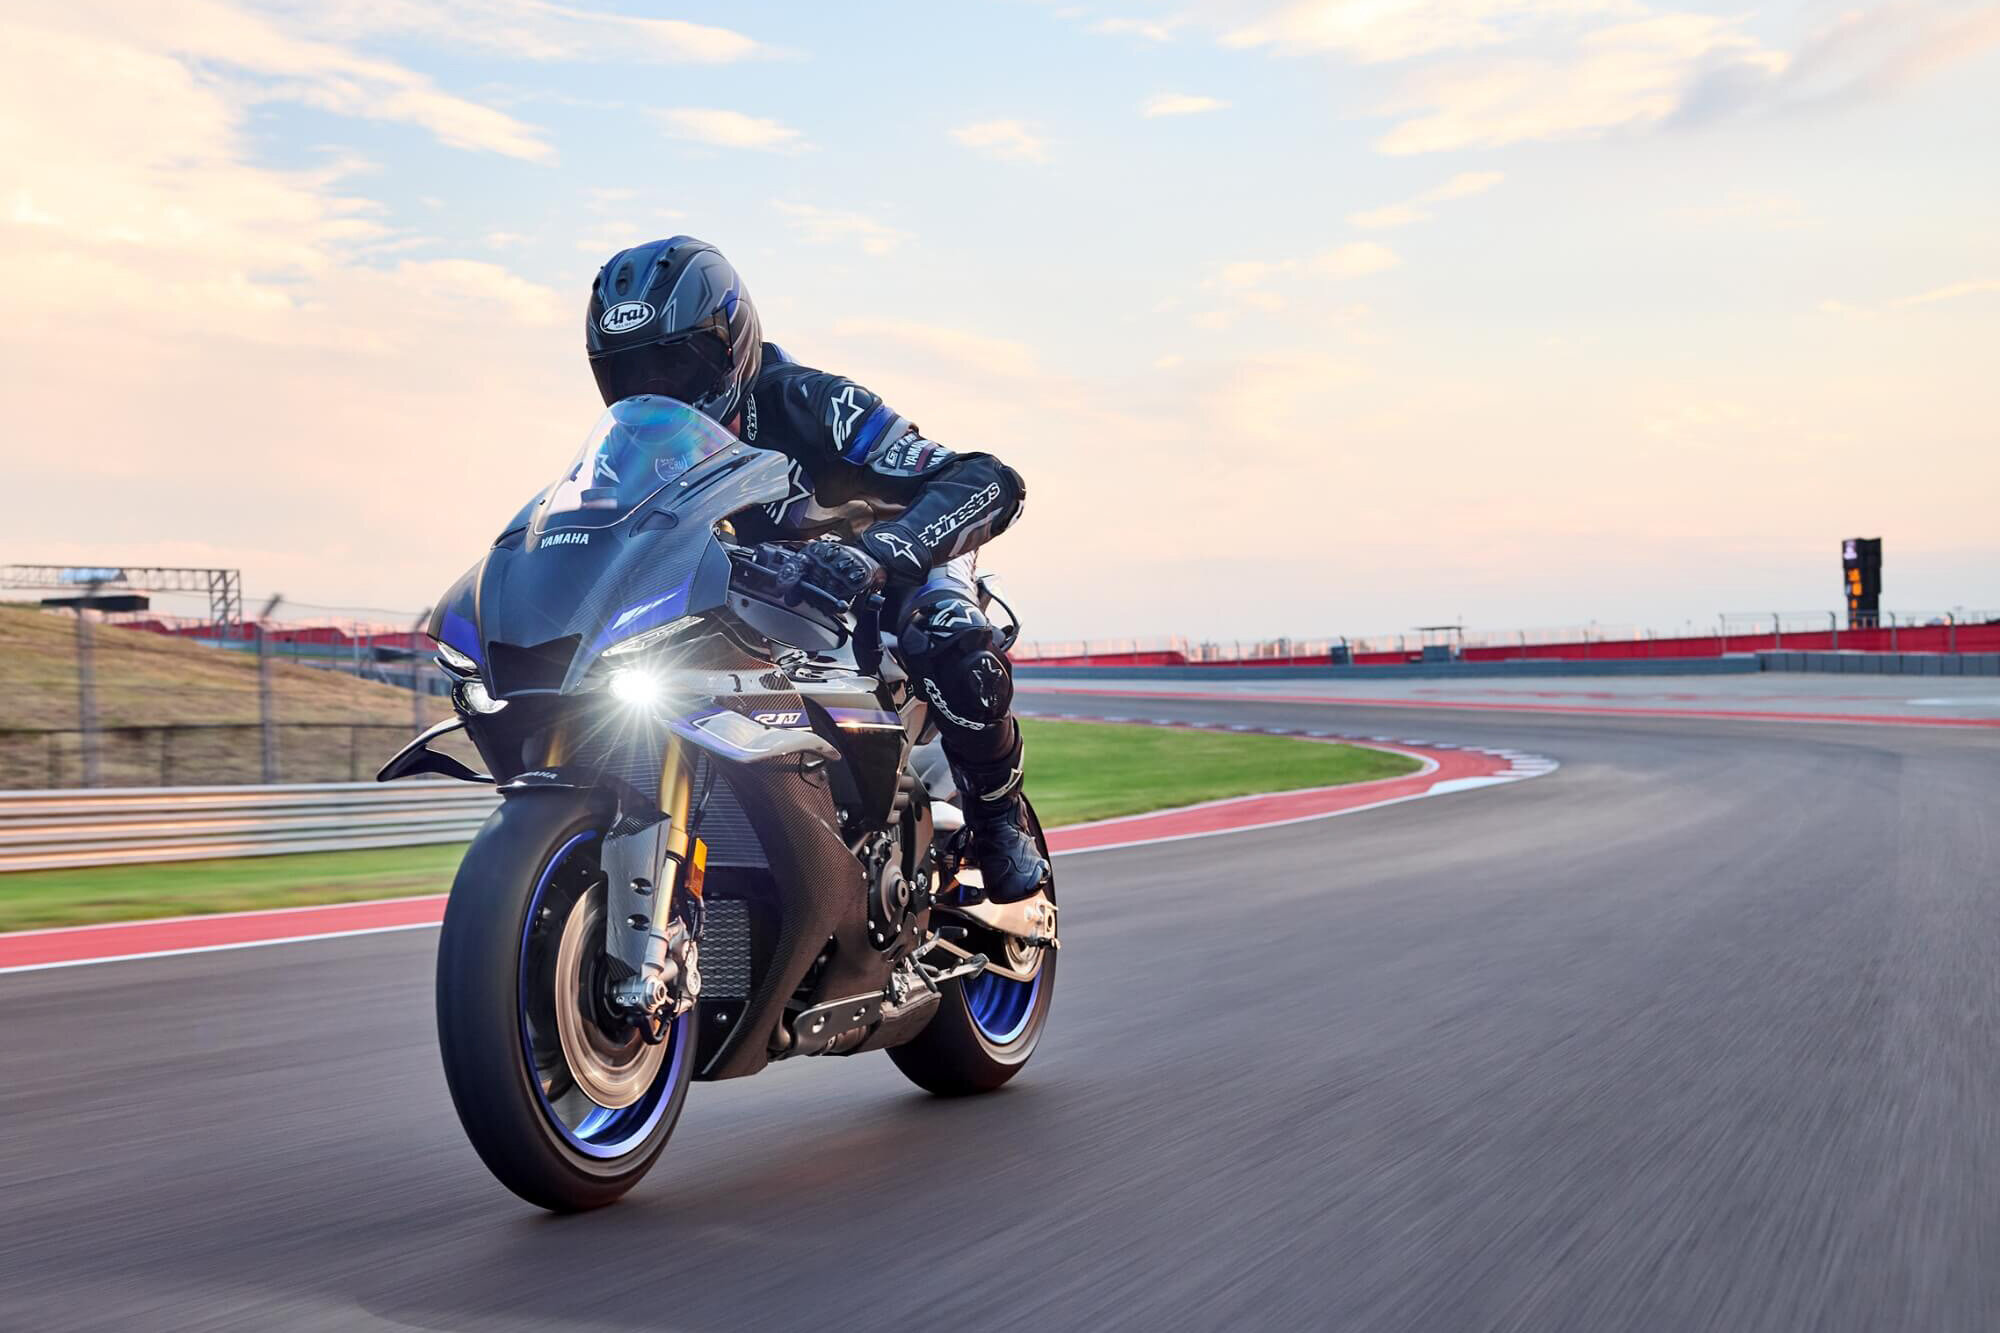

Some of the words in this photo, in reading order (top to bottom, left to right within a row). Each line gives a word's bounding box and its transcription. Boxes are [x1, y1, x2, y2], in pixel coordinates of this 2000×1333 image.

[604, 303, 646, 329] Arai
[903, 440, 929, 465] YAMA
[918, 482, 1000, 547] alpinestars
[540, 533, 589, 549] YAMAHA
